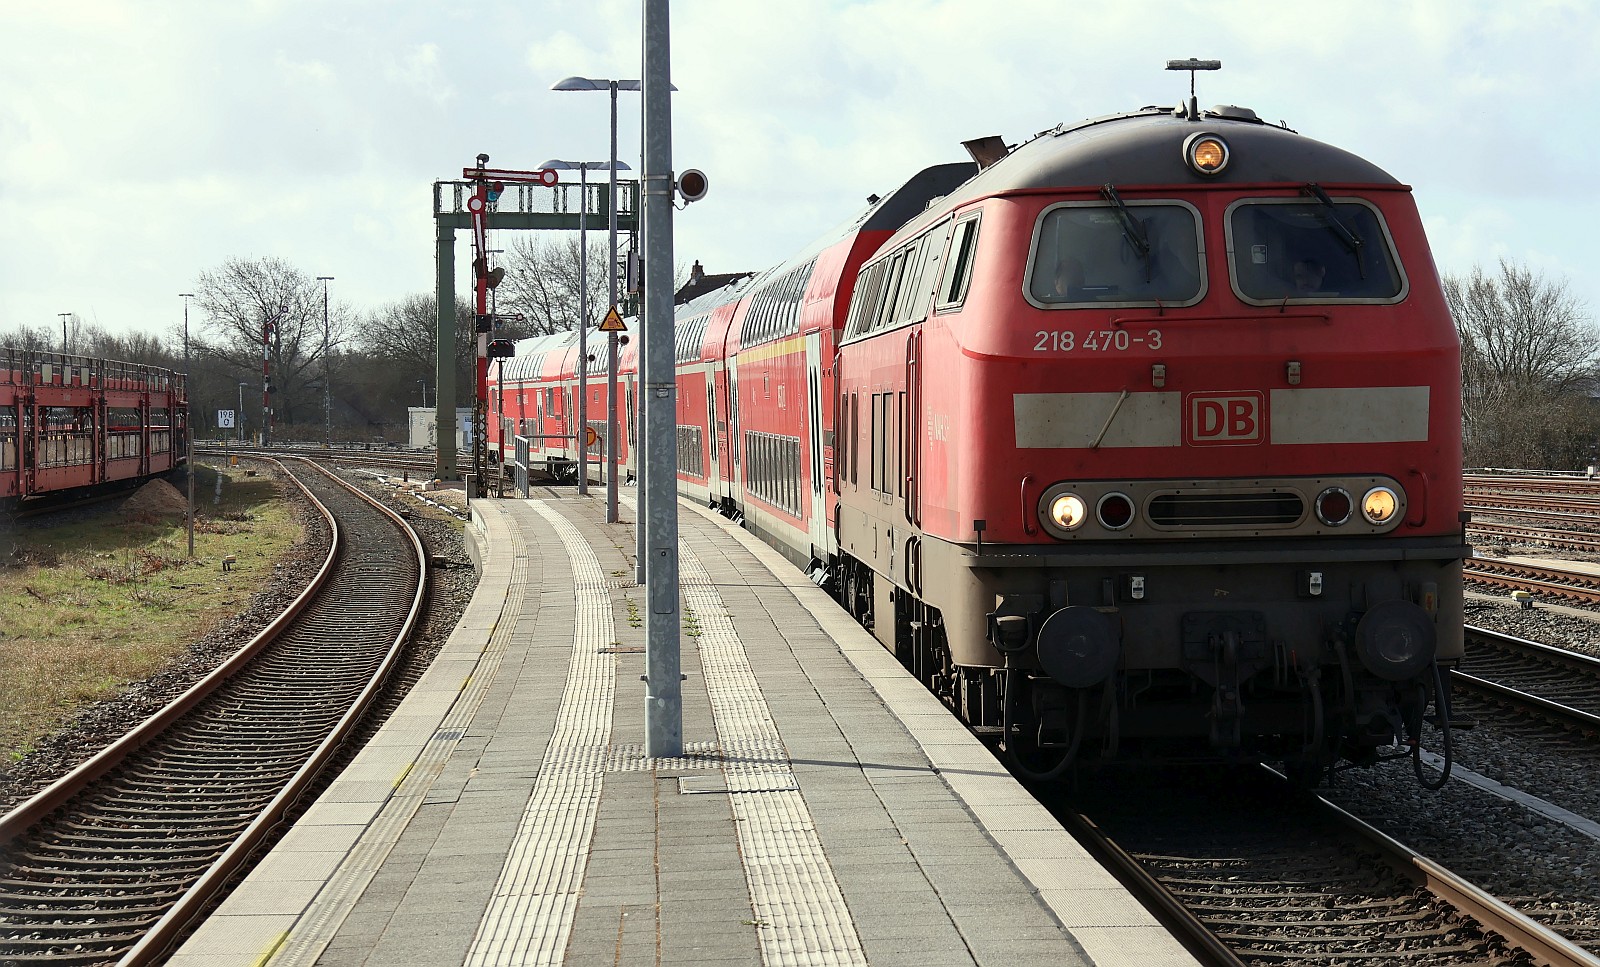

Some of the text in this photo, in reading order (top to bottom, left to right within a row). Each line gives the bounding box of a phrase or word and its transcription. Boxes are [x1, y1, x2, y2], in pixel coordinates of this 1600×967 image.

[1033, 329, 1162, 351] 218 470-3
[1197, 400, 1255, 437] DB
